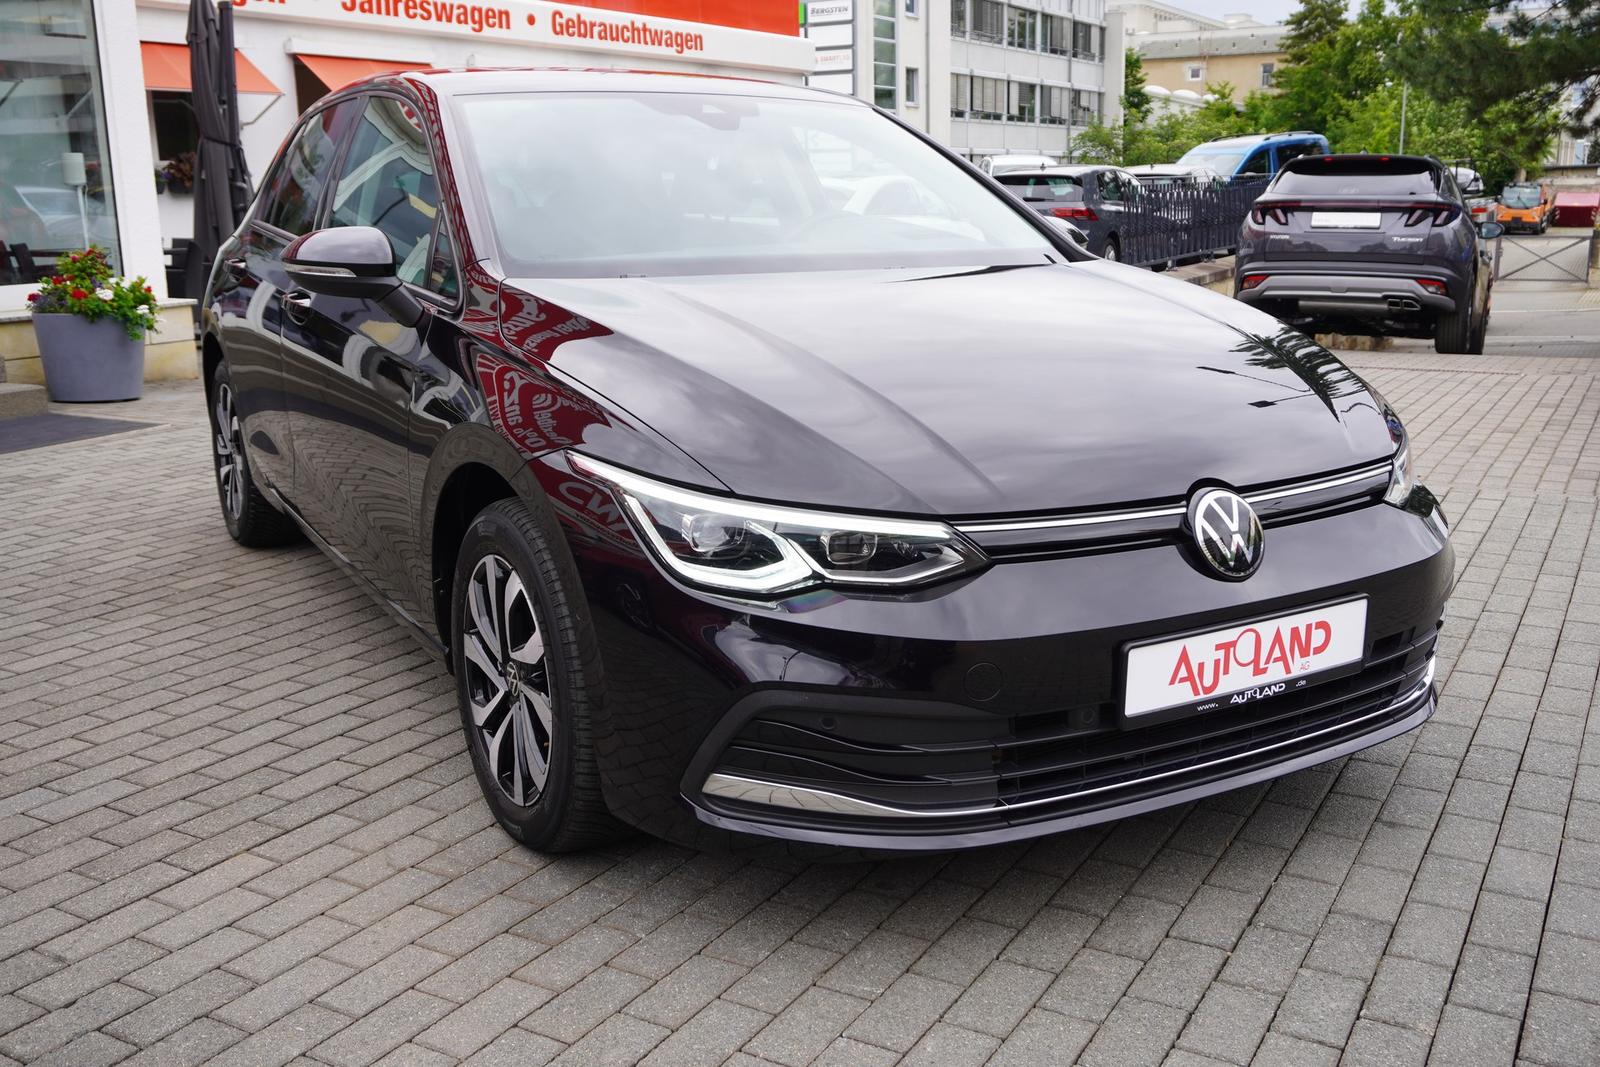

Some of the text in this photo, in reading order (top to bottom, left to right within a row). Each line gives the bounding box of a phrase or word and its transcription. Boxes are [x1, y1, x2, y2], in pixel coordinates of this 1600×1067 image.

[551, 11, 704, 53] Gebrauchtwagen
[1169, 620, 1332, 696] AUTOLAND
[1230, 683, 1286, 704] AUTOLAND
